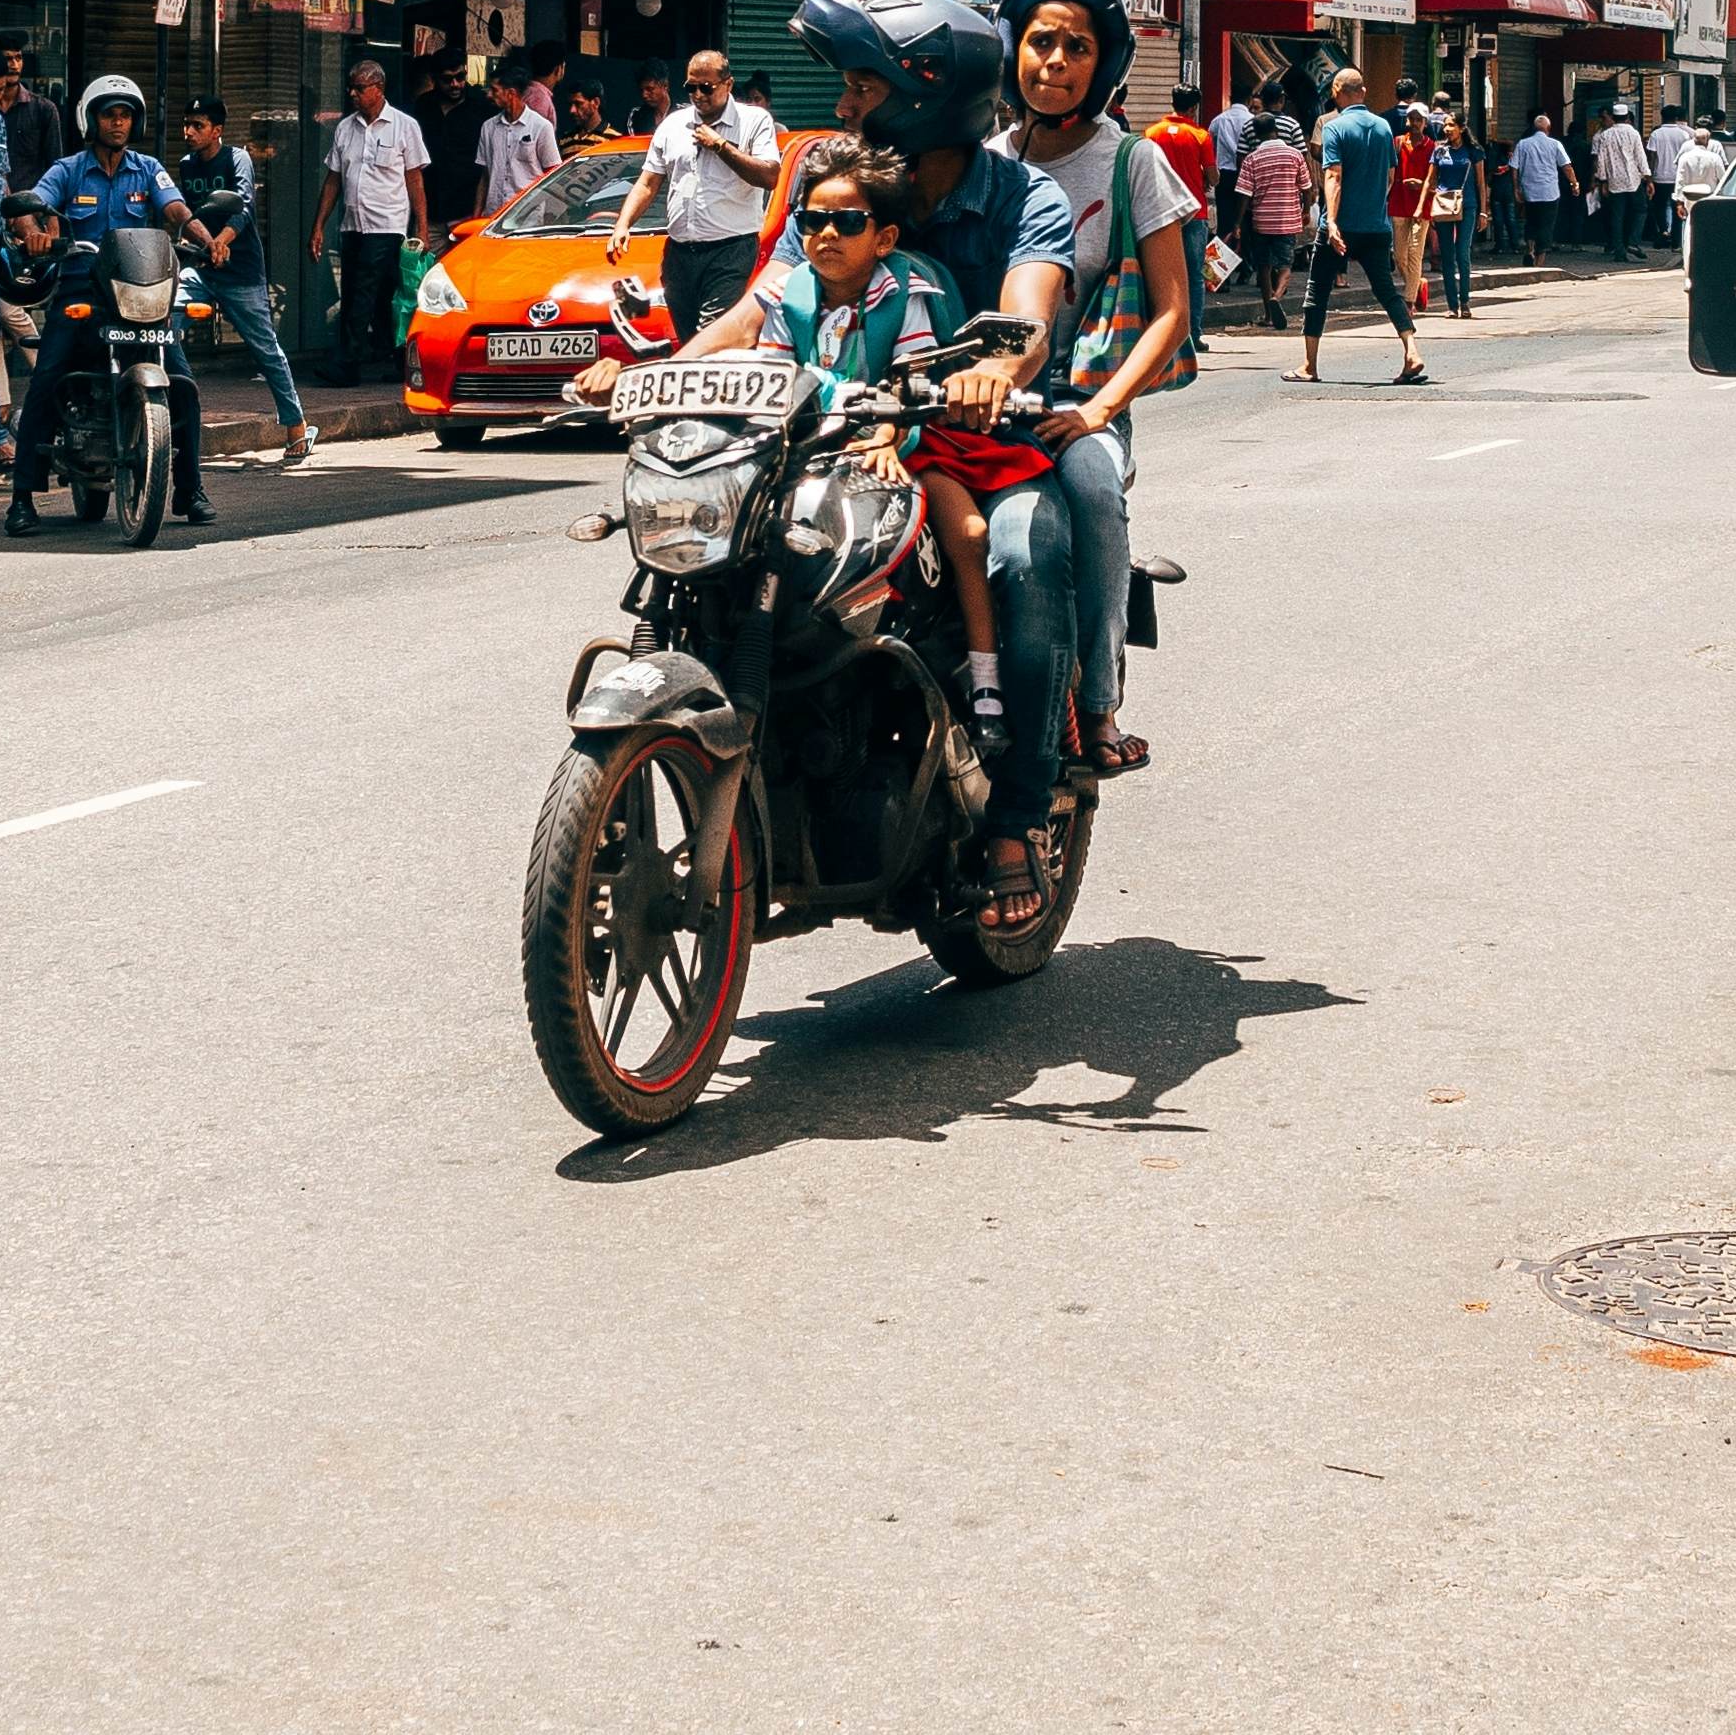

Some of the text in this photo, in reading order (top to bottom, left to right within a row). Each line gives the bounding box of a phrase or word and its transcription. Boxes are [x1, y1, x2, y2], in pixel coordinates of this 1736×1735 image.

[140, 329, 175, 344] 3984
[506, 337, 595, 358] CAD 4262
[614, 390, 637, 414] SP
